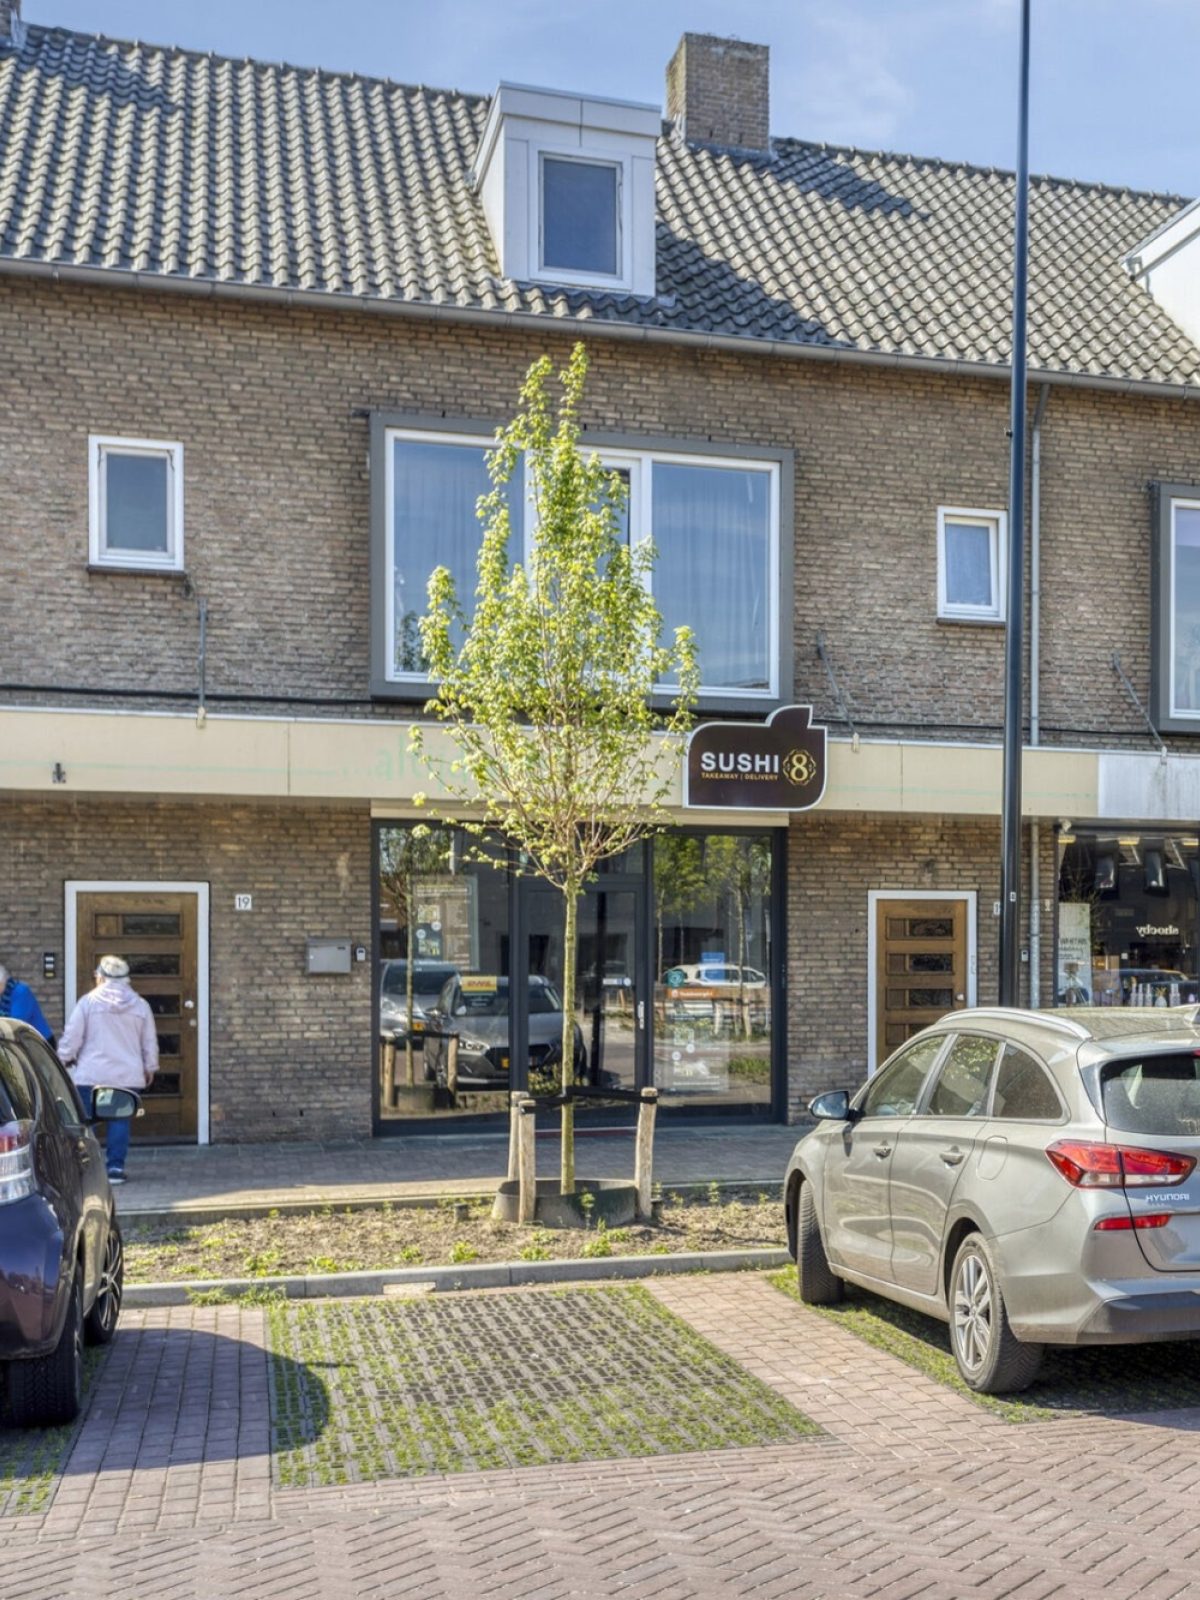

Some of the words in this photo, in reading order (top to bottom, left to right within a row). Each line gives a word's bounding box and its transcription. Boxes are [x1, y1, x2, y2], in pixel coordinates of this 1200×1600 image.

[701, 752, 779, 773] SUSHI
[789, 753, 809, 781] 8
[701, 772, 739, 780] TAKEAWAY
[237, 896, 250, 909] 19
[1145, 1193, 1190, 1202] HYUNDAI
